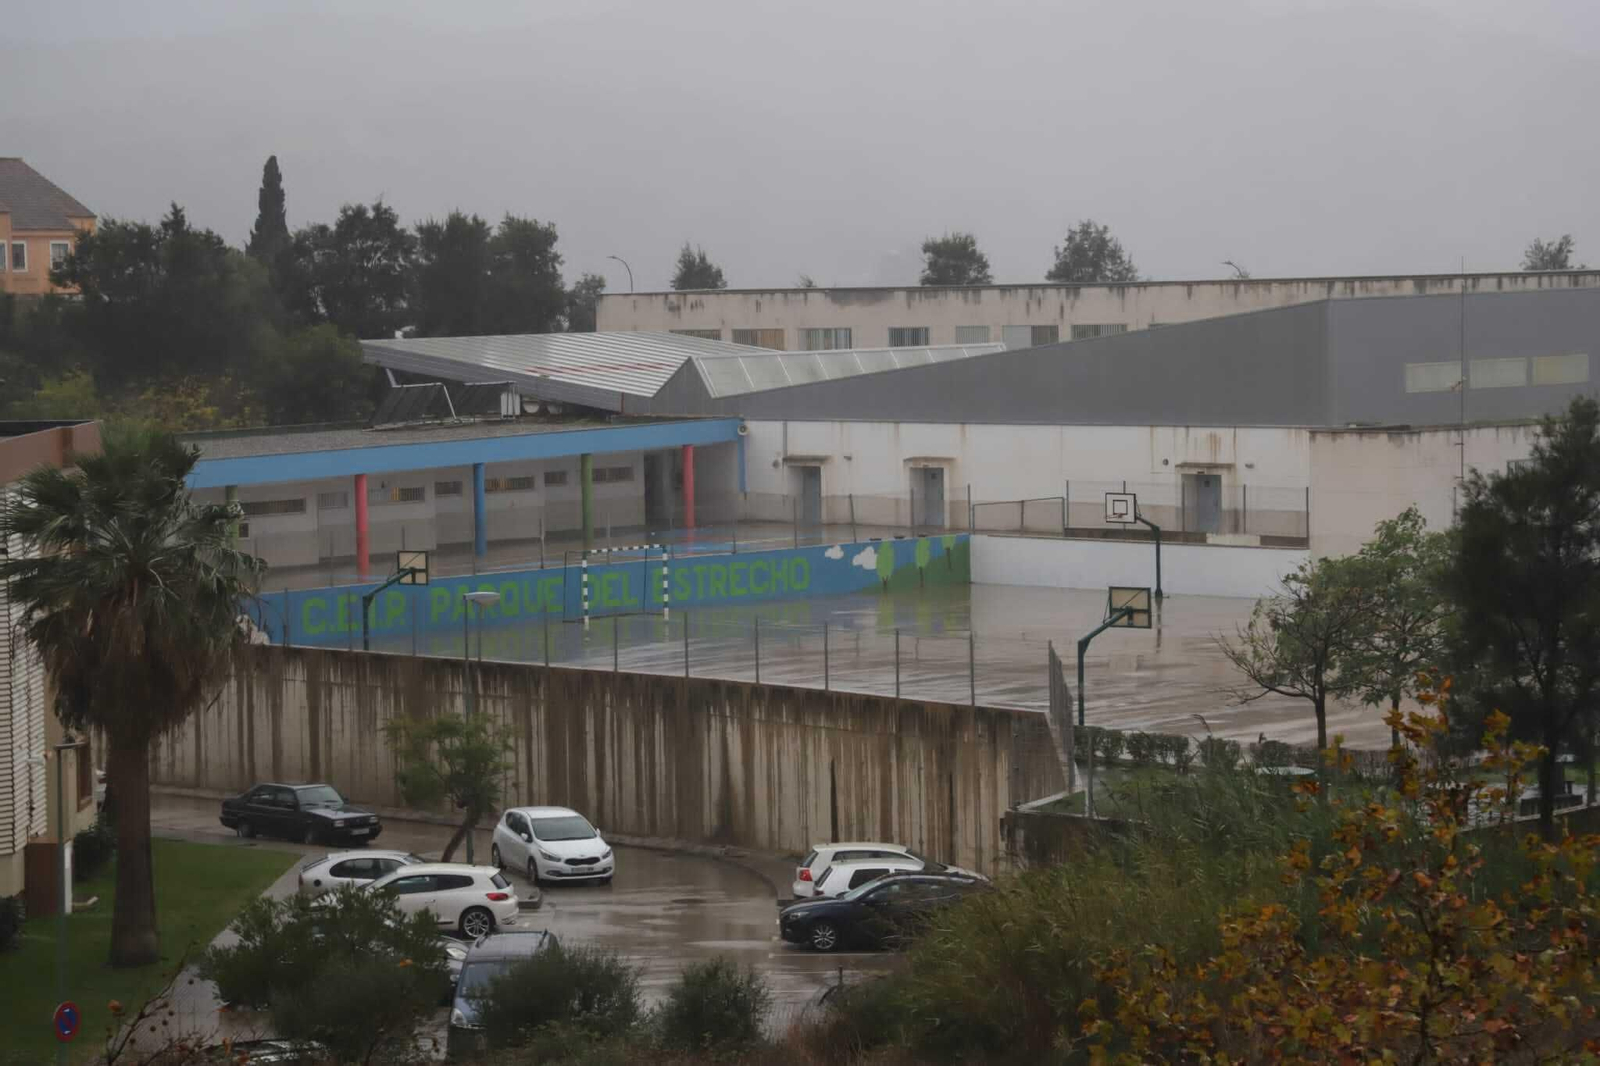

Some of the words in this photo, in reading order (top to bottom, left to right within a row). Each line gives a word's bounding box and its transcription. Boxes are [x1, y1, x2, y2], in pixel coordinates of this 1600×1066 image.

[302, 591, 406, 634] C.EI.P.
[582, 571, 638, 609] DEL
[652, 557, 812, 604] ESTRECHO
